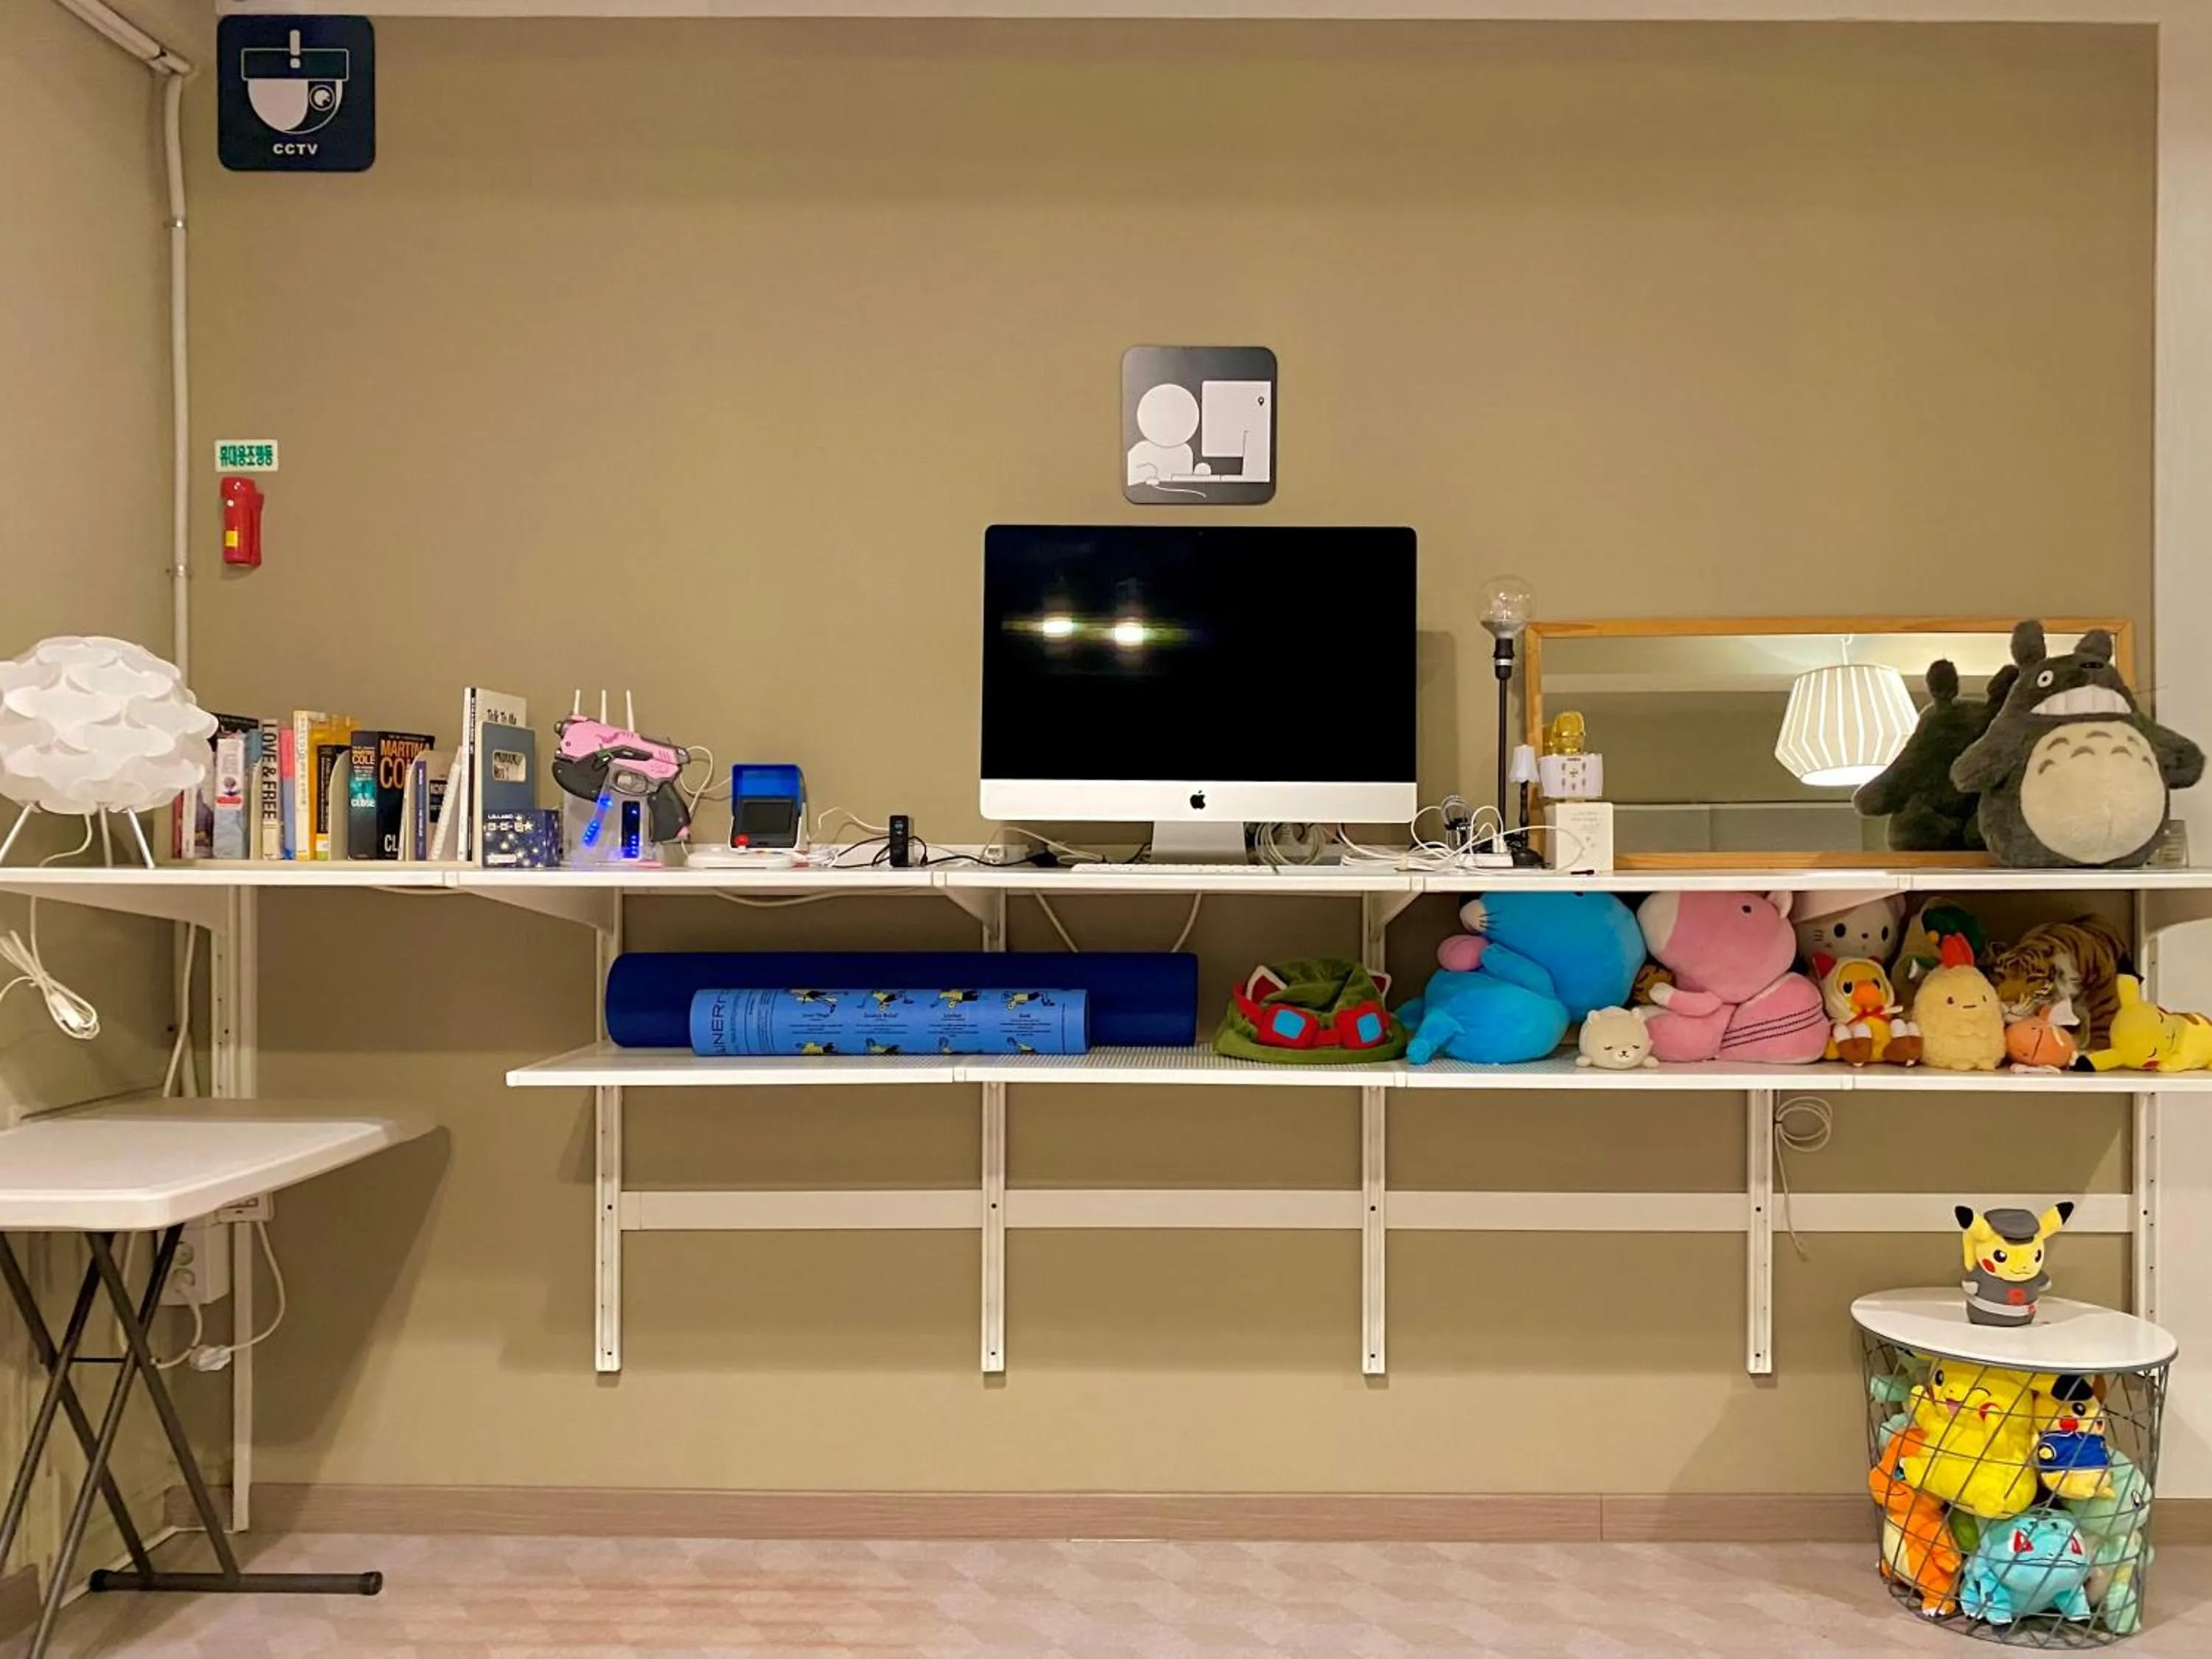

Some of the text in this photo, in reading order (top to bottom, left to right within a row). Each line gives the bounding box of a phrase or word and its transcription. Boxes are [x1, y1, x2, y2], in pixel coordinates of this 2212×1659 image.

[272, 143, 319, 156] CCTV
[262, 723, 277, 819] LOVE & FREE
